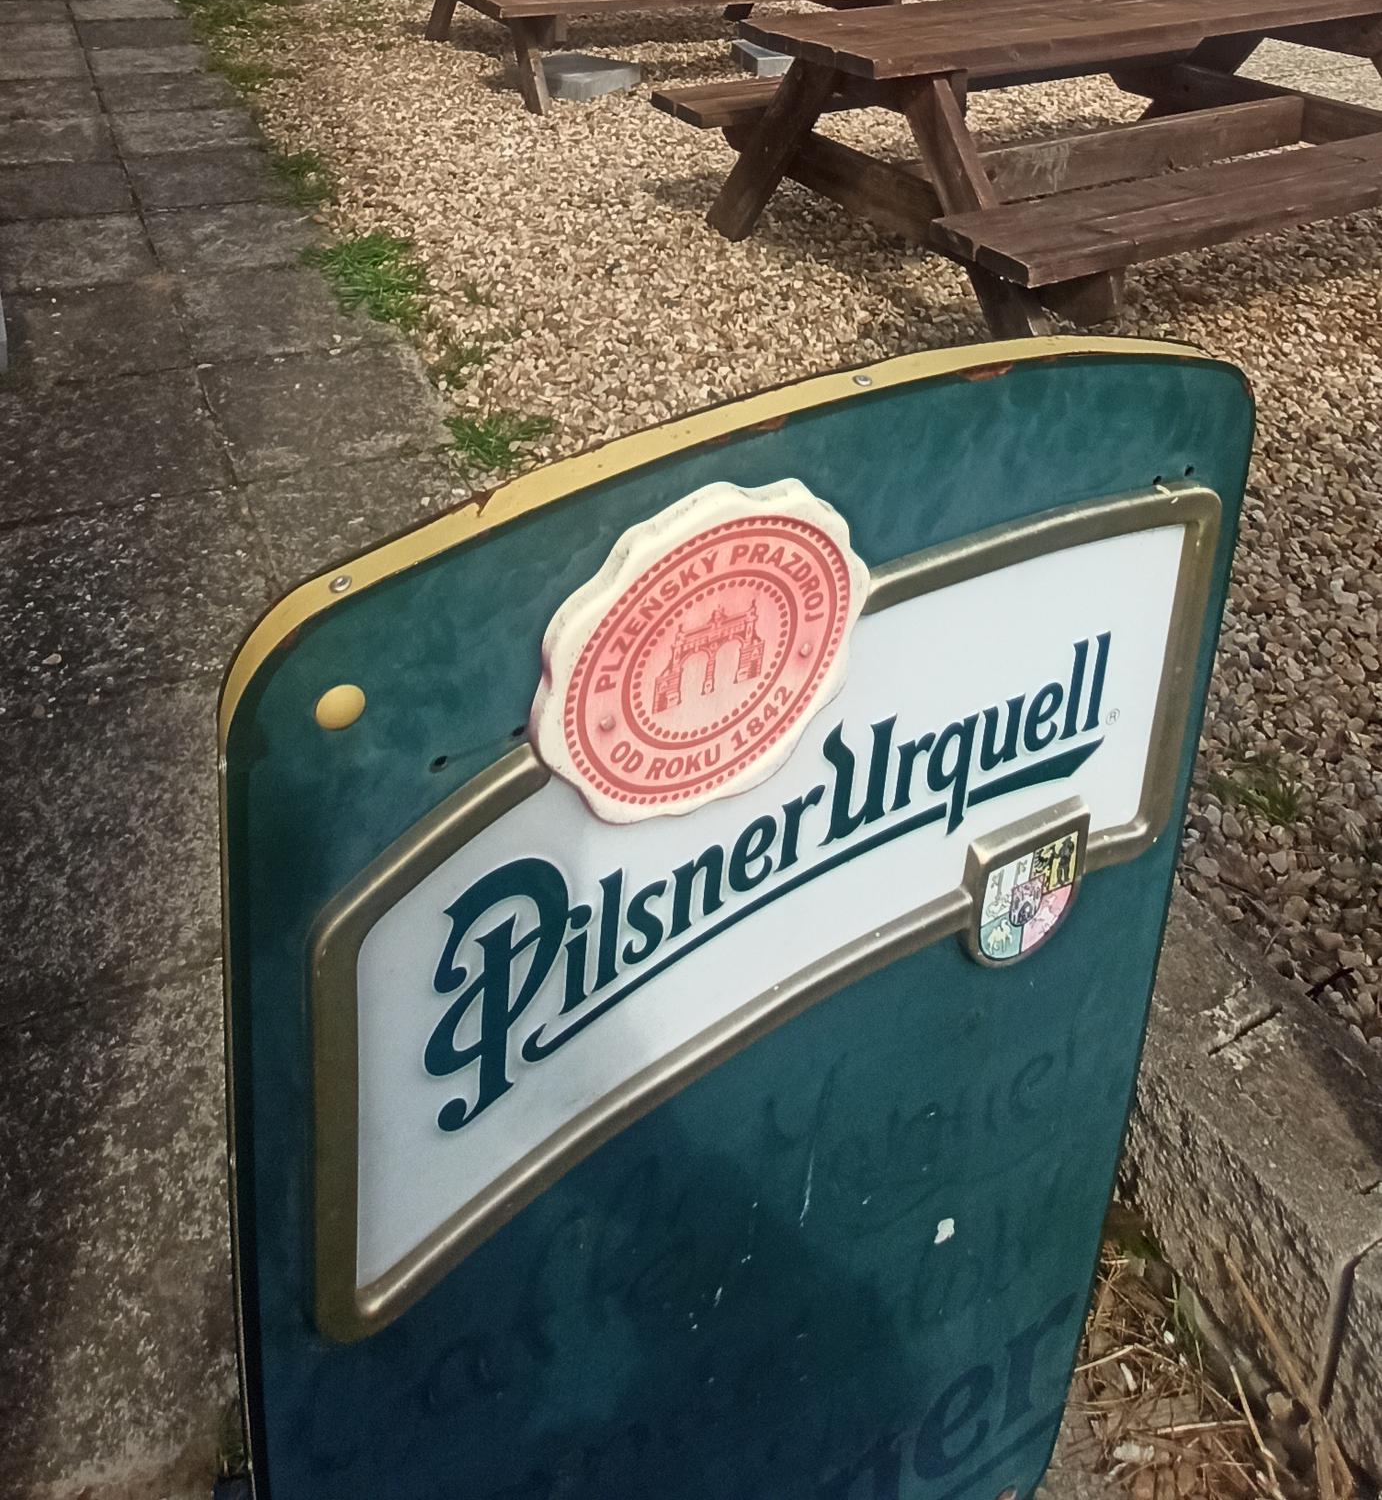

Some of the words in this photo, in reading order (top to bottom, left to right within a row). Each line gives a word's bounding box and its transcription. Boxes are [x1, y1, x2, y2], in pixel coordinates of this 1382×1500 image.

[594, 549, 720, 694] PLZEŇSKÝ
[729, 542, 825, 623] PRAZDROJ
[609, 740, 644, 774] OD
[645, 743, 721, 781] ROKU
[730, 685, 794, 752] 1842
[423, 782, 827, 1134] Pilsner
[818, 630, 1112, 846] Urquell
